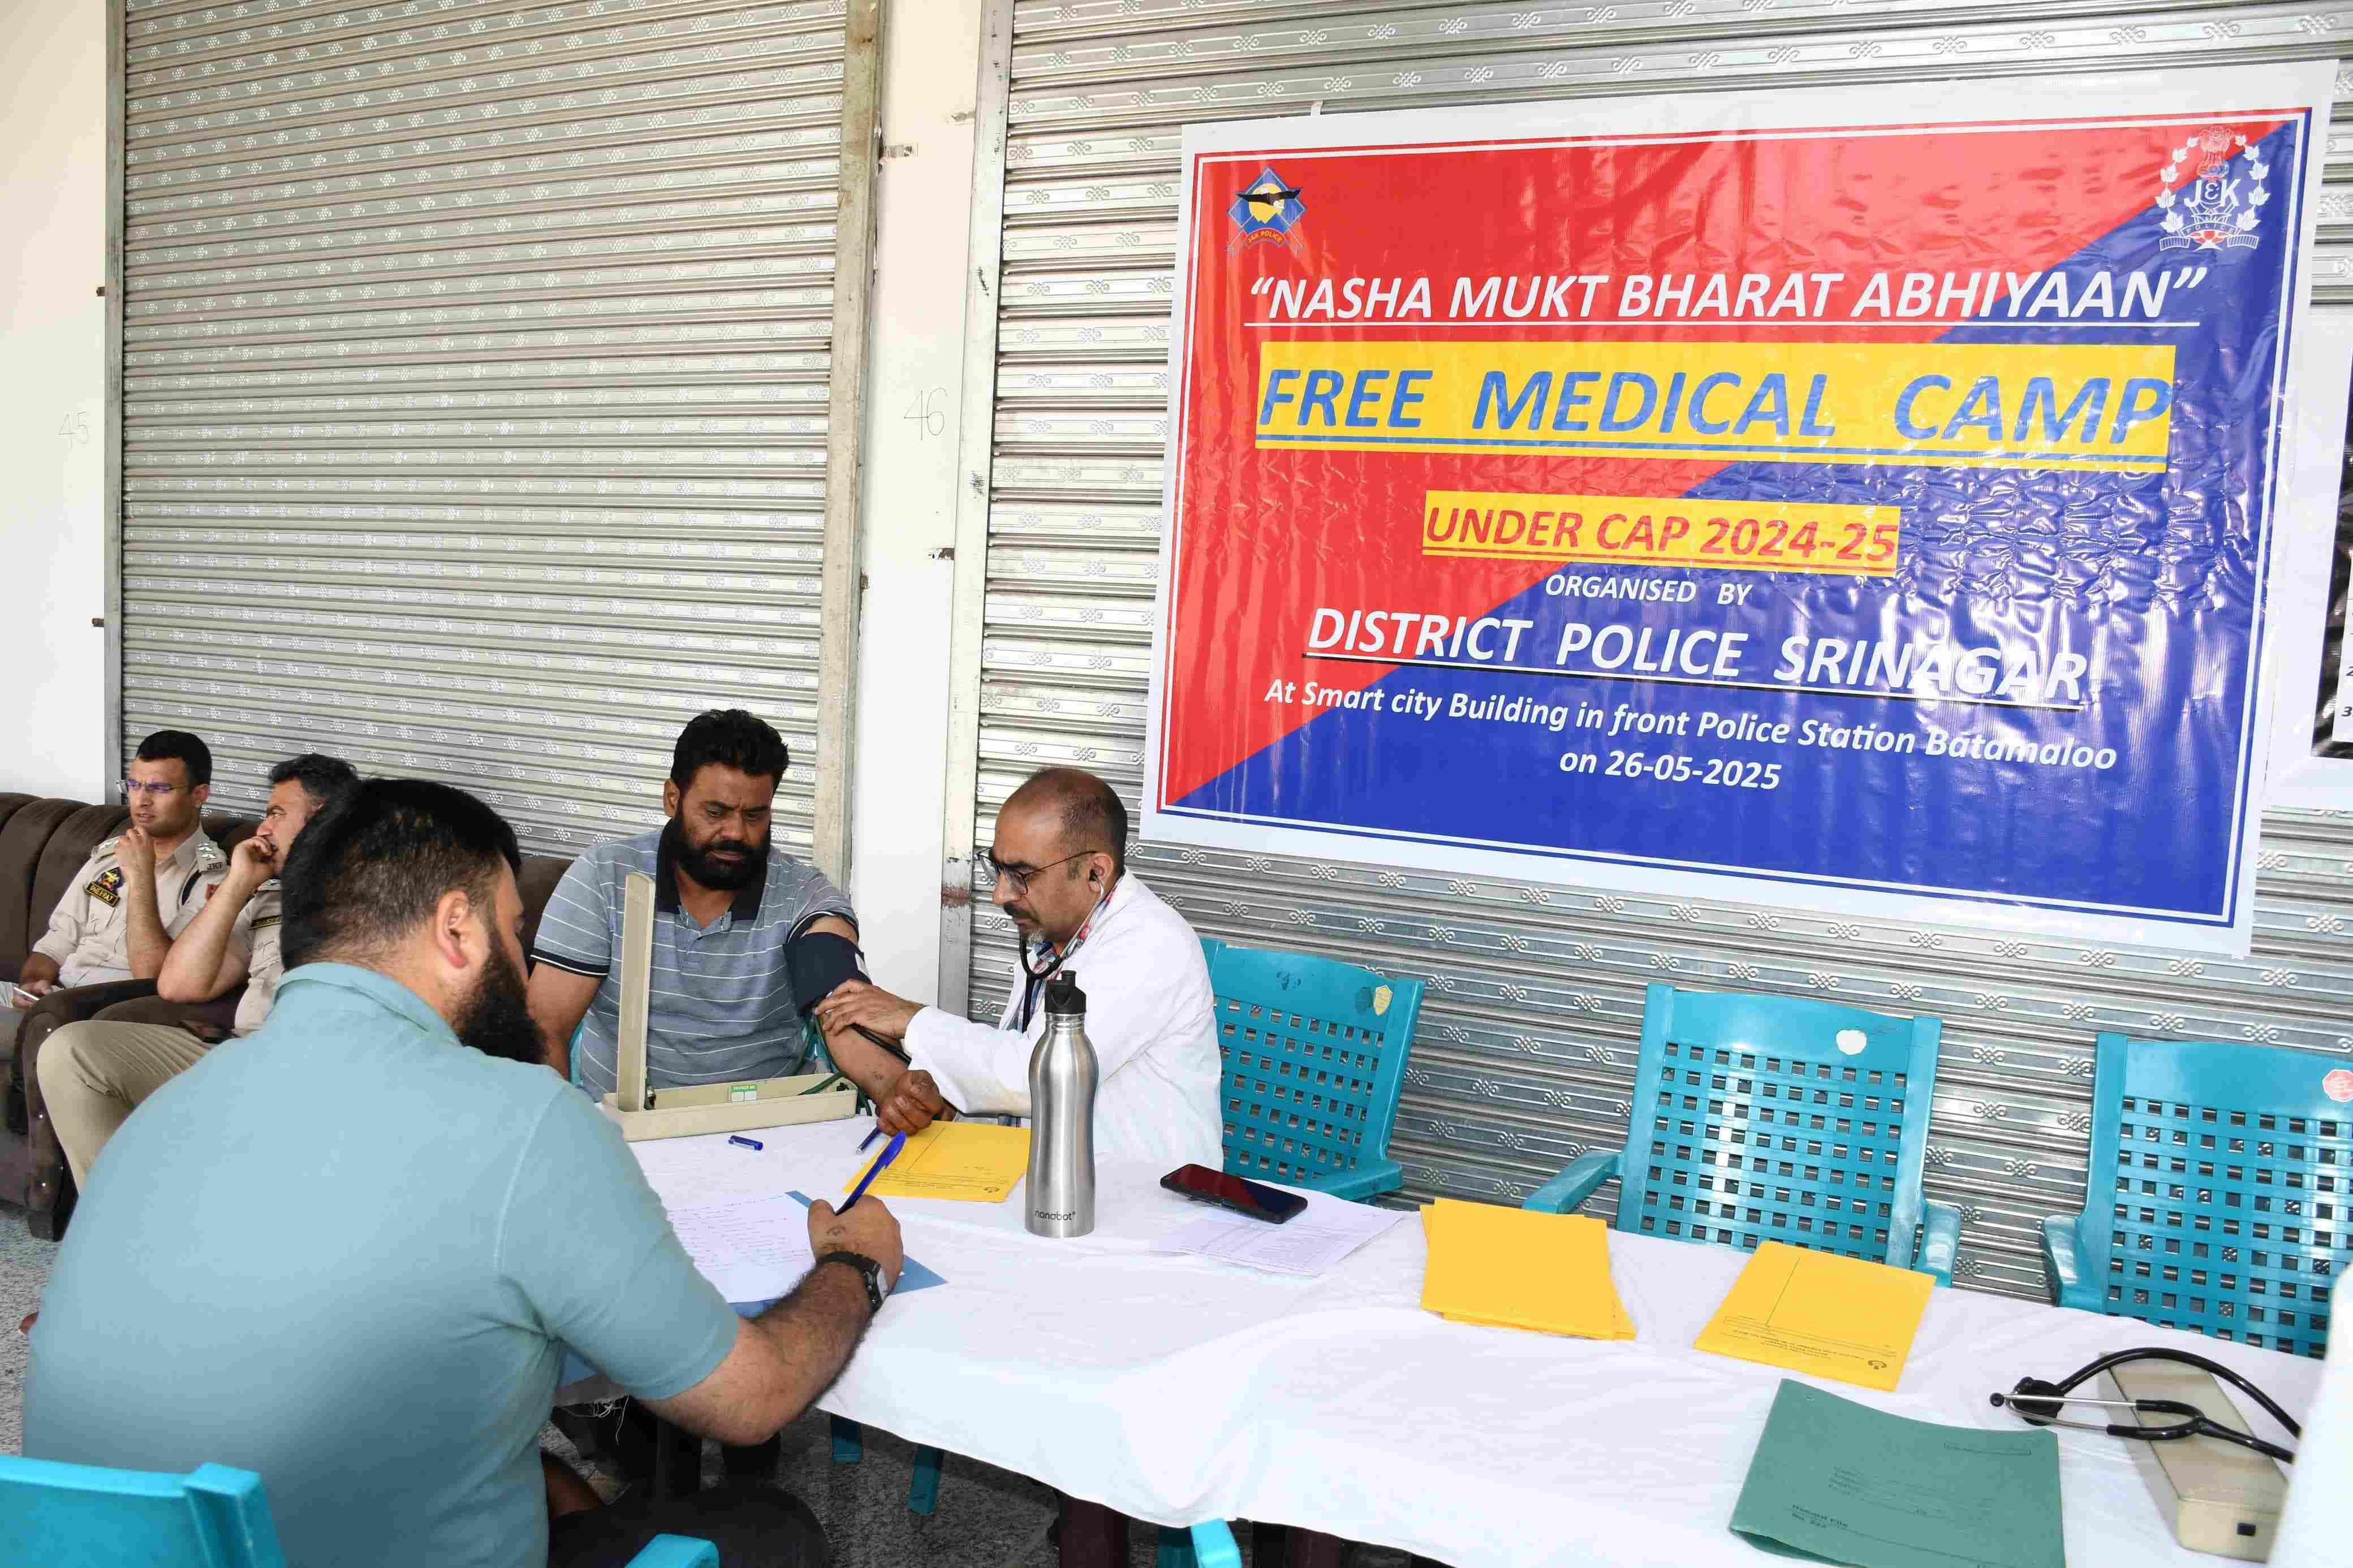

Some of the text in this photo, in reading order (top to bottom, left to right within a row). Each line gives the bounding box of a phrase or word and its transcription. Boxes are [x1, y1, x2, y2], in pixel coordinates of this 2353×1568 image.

[1251, 267, 2208, 318] “NASHA MUKT BHARAT ABHIYAAN”
[58, 411, 89, 448] 45
[903, 387, 948, 441] 46
[1259, 369, 2174, 444] FREE MEDICAL CAMP
[1425, 507, 1900, 563] UNDER CAP 2024-25
[1545, 573, 1754, 607] ORGANISED BY
[1307, 607, 2087, 701] DISTRICT POLICE SRINAGAR
[1264, 679, 2118, 770] At Smart city Building in front Police Station Batamaloo
[1559, 750, 1783, 790] on 26-05-2025
